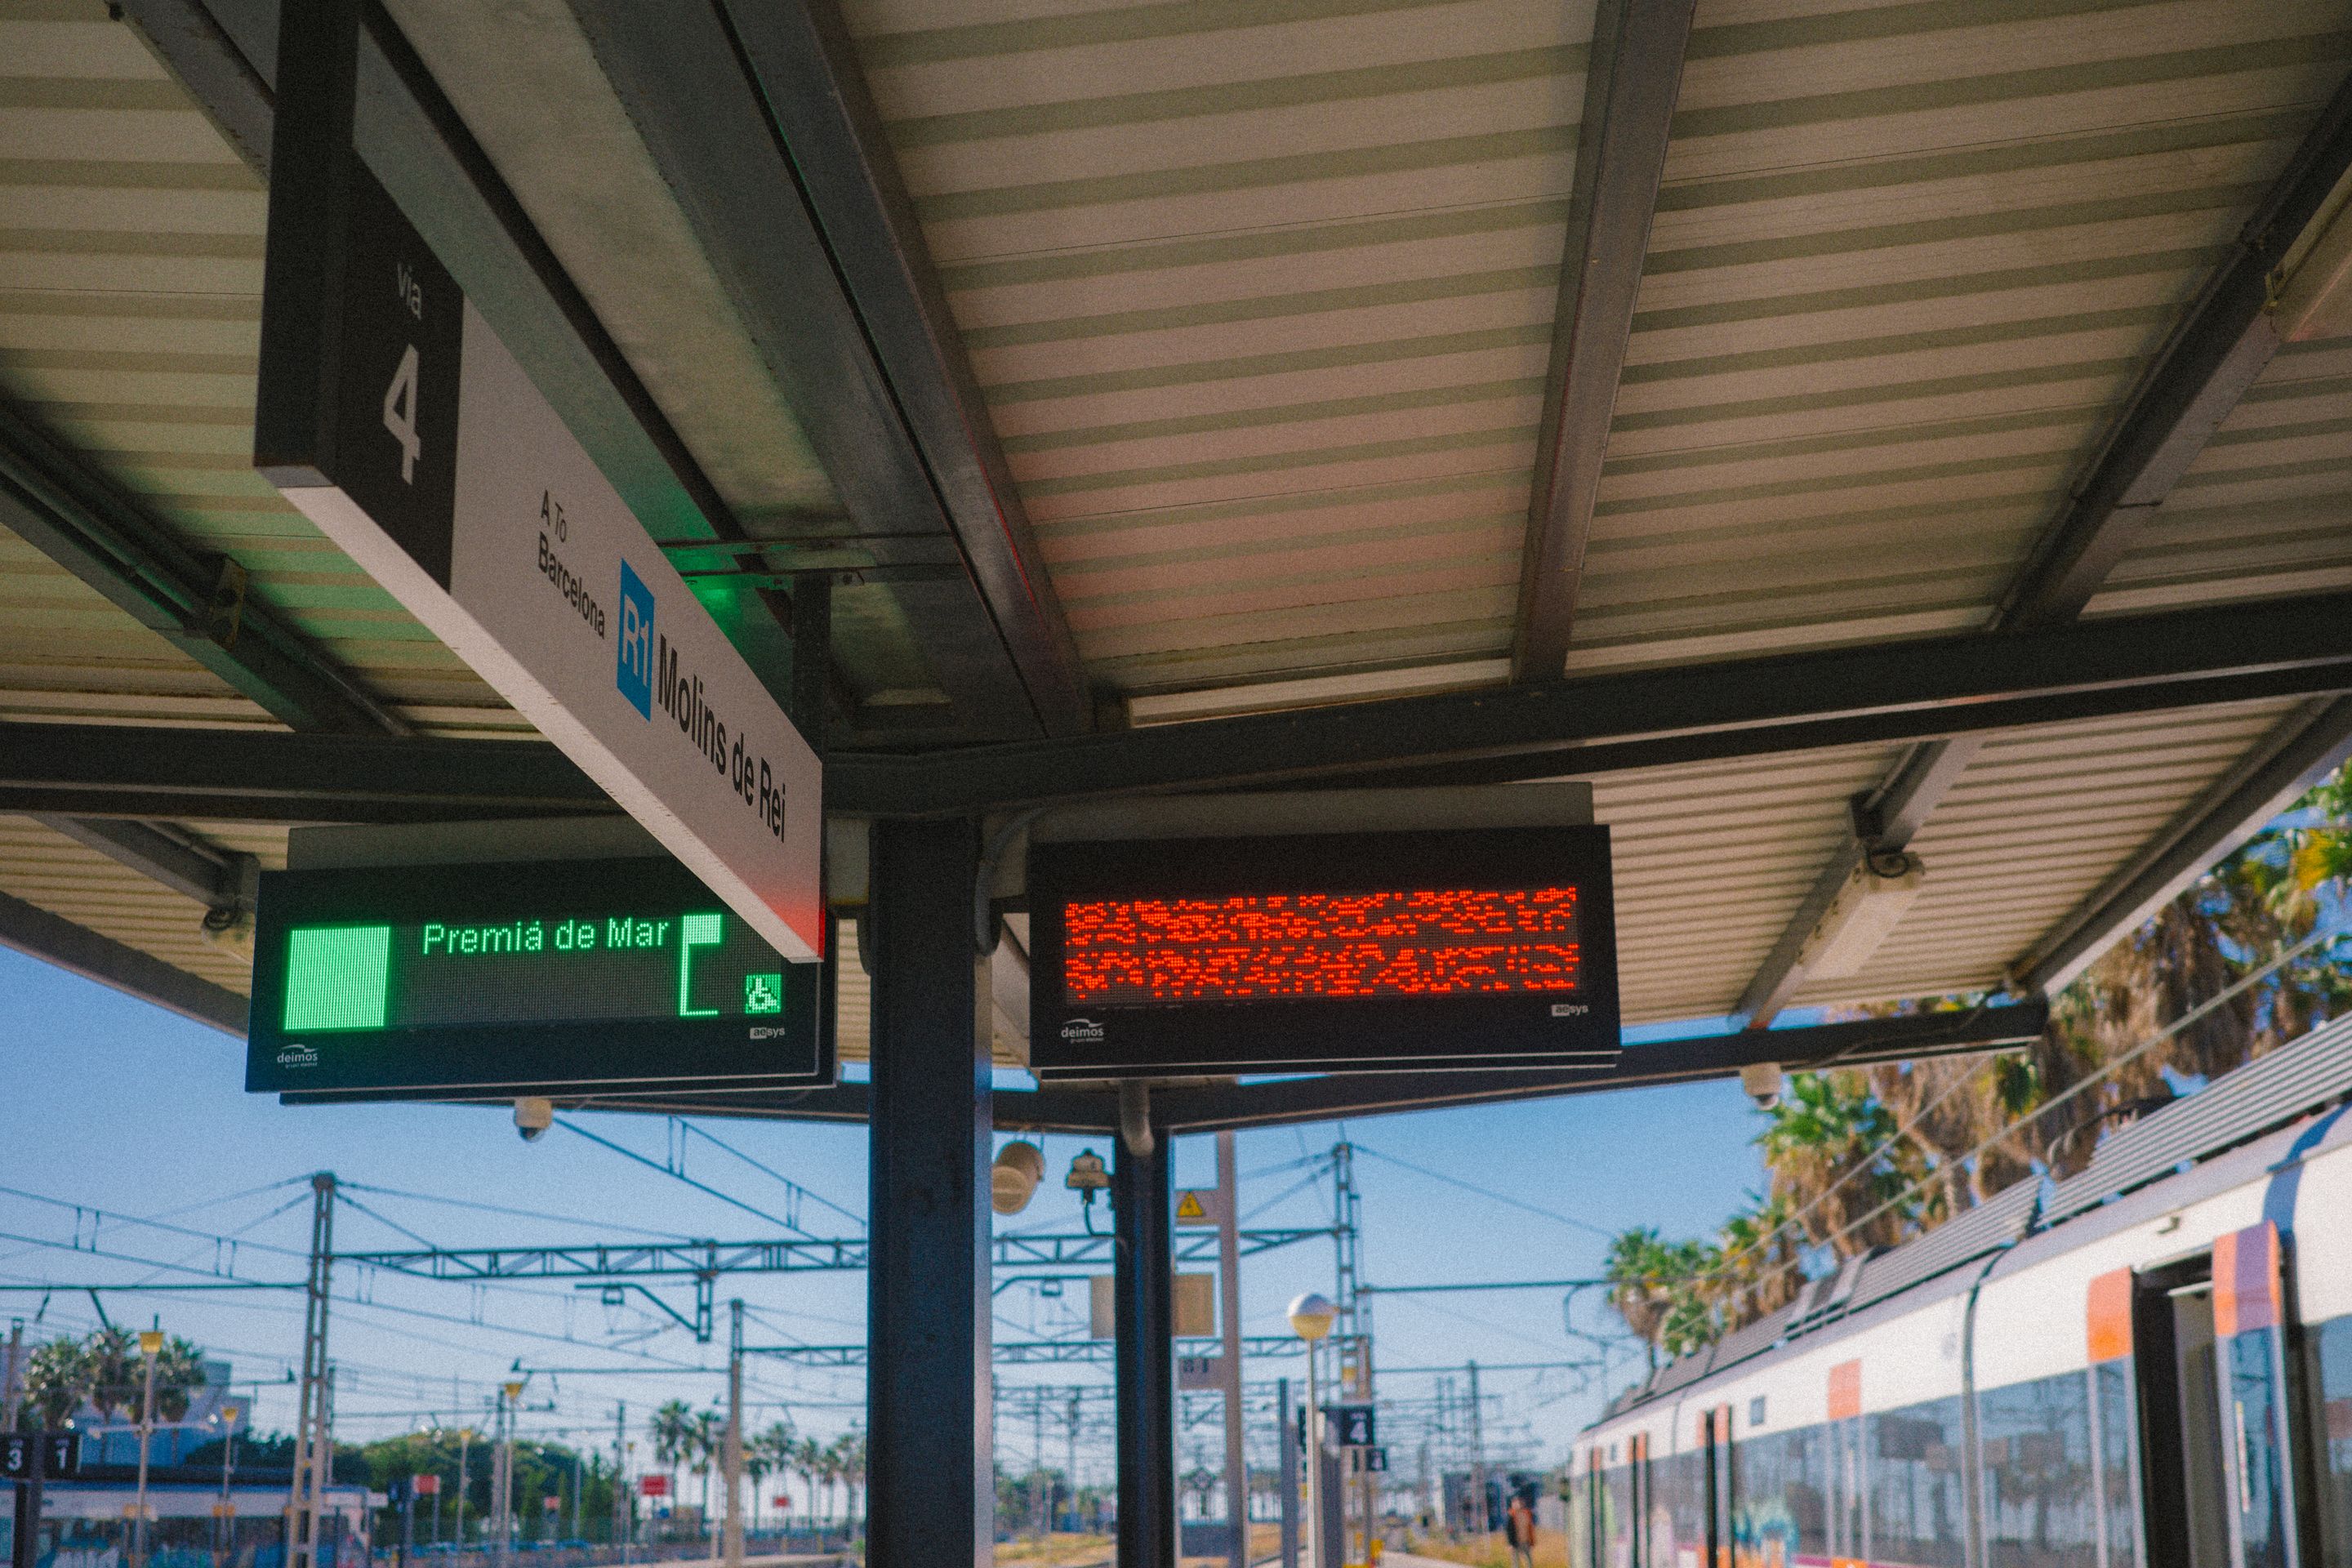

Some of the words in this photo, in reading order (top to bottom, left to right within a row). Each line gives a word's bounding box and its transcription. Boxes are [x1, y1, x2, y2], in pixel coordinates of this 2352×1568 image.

[383, 344, 421, 485] 4
[541, 490, 551, 527] A
[555, 502, 568, 543] To
[538, 532, 605, 639] Barcelona
[622, 593, 651, 688] R1
[658, 633, 727, 777] Molins
[732, 732, 755, 807] de
[760, 756, 786, 843] Rei
[556, 919, 595, 950] de
[608, 916, 670, 948] Mar
[750, 1027, 786, 1039] aesys
[1061, 1026, 1104, 1038] deimos
[277, 1052, 318, 1062] deimos
[1349, 1420, 1367, 1444] 4
[7, 1447, 23, 1472] 3
[56, 1446, 67, 1469] 1
